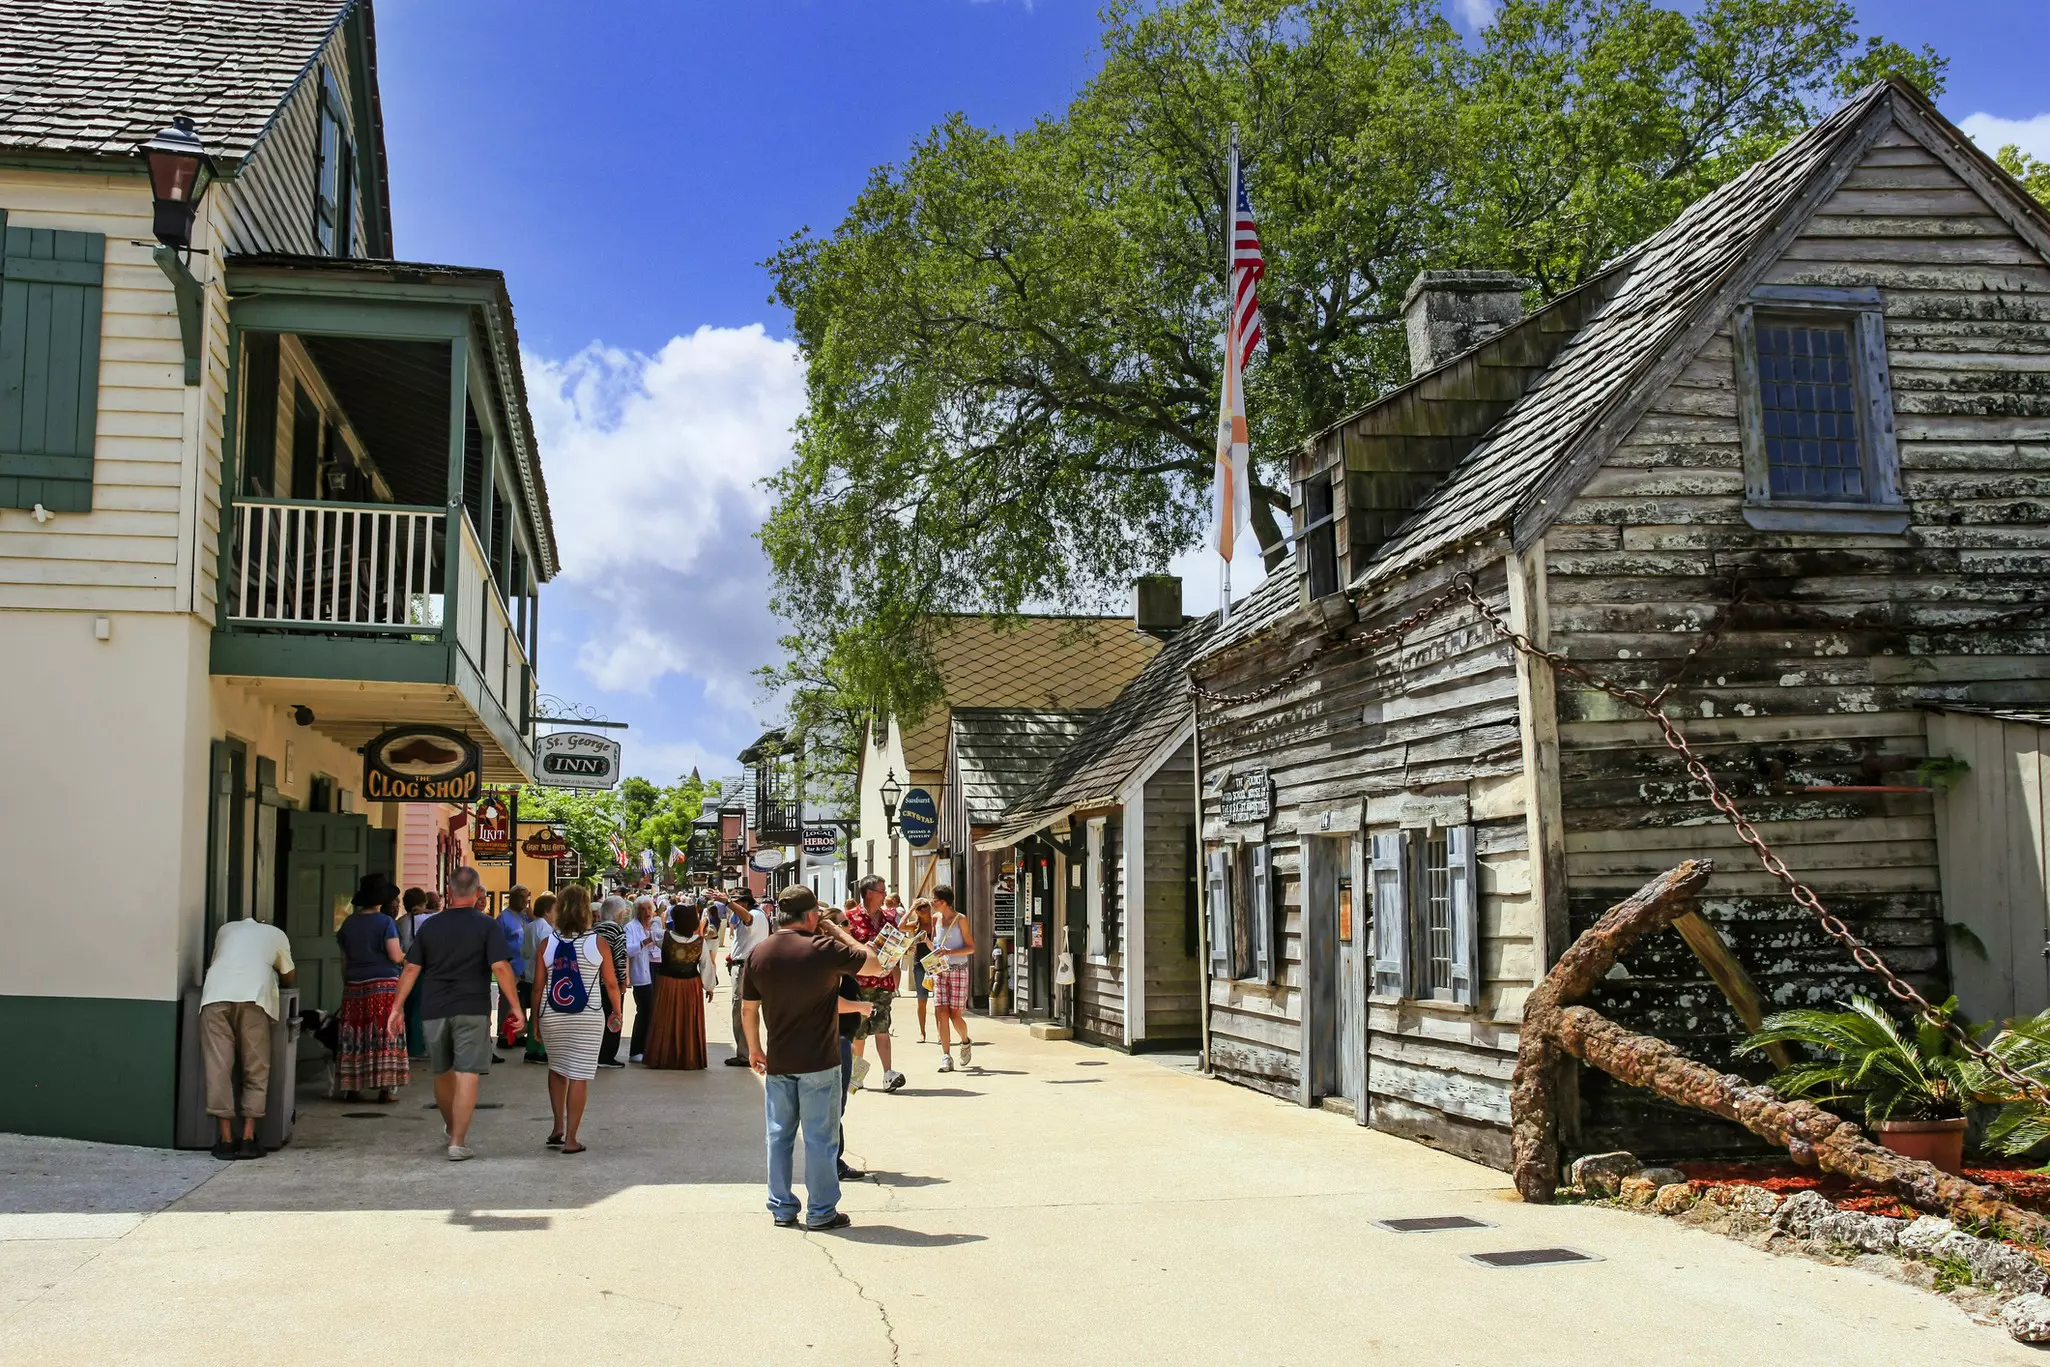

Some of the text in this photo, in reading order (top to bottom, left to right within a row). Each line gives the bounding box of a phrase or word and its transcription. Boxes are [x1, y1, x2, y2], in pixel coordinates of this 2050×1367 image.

[546, 735, 611, 753] St. George
[554, 757, 600, 772] INN
[368, 769, 477, 798] CLOG SHOP
[905, 796, 930, 804] Sunburst
[902, 810, 934, 823] CRYSTAL
[804, 837, 835, 846] HEROS
[552, 976, 575, 1006] C
